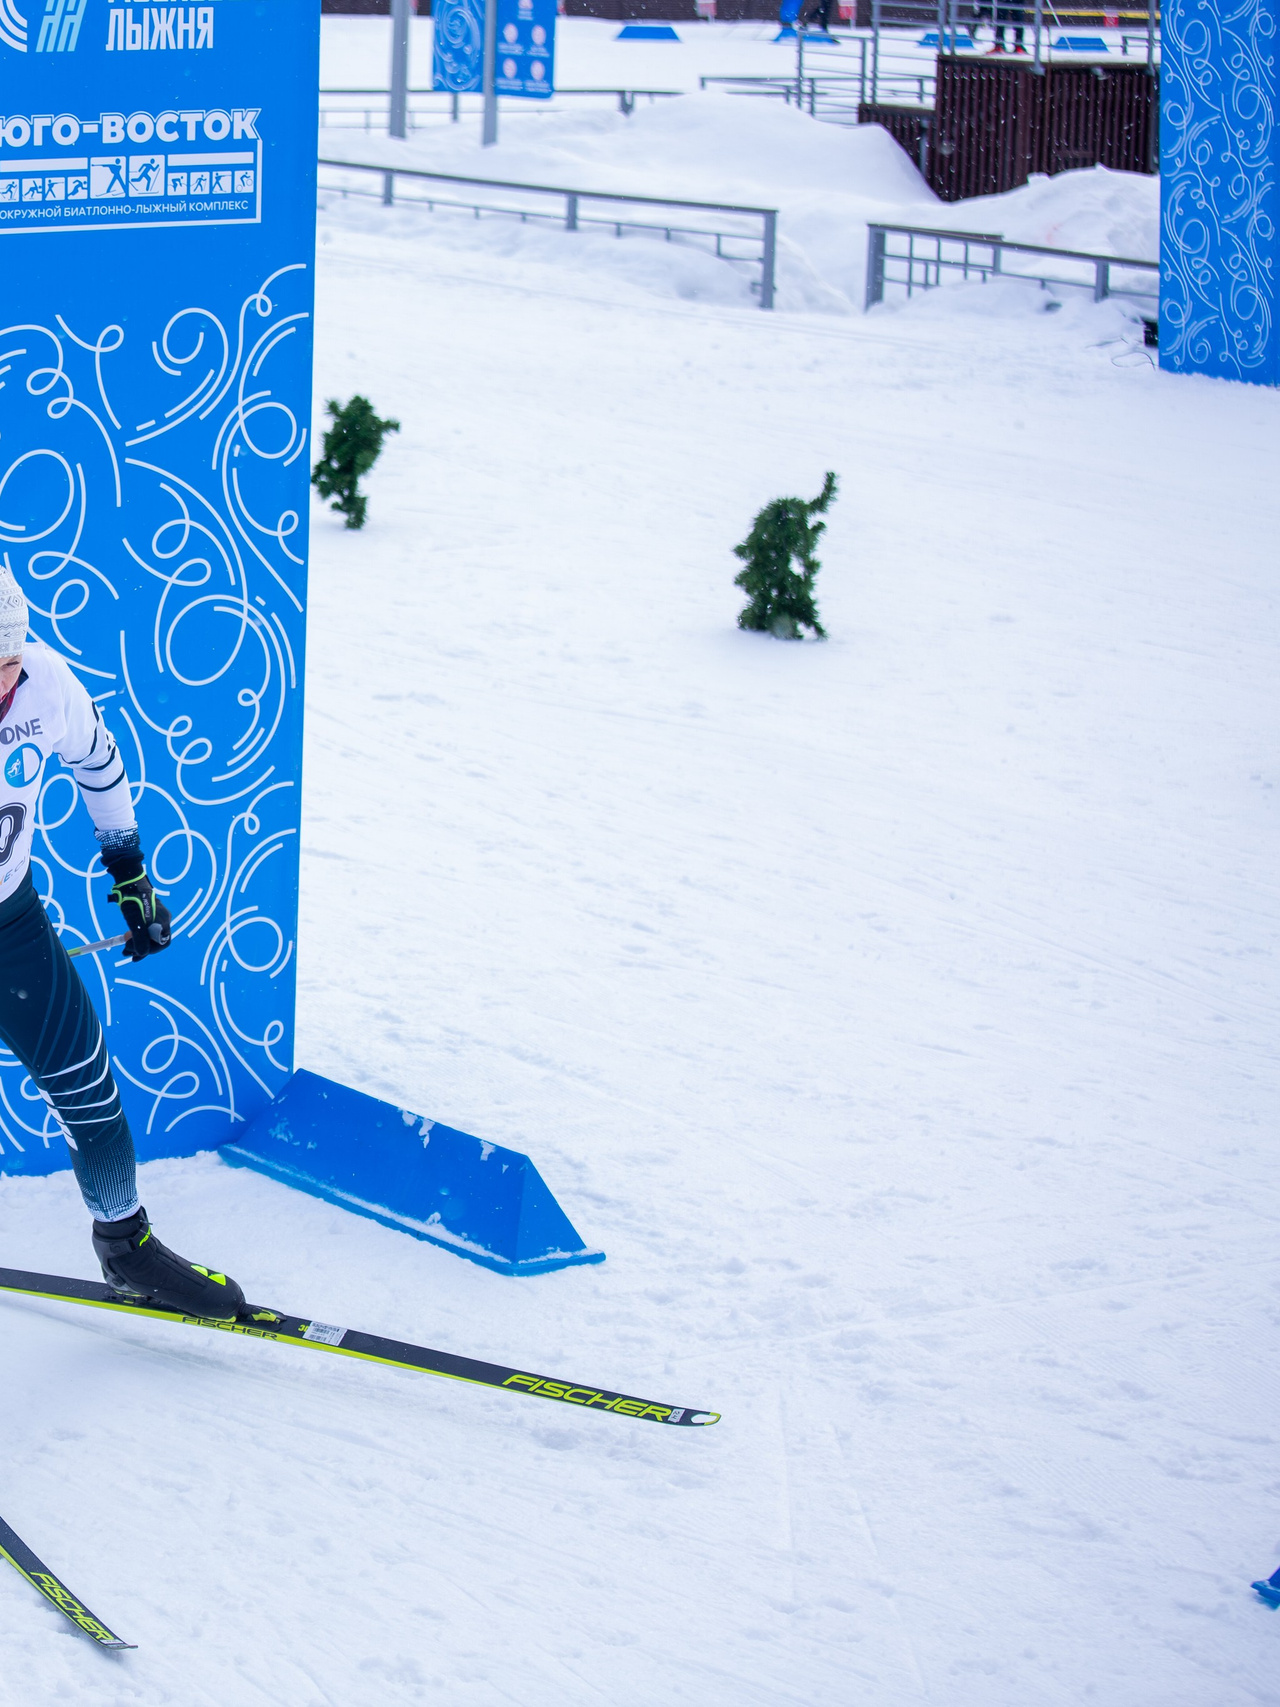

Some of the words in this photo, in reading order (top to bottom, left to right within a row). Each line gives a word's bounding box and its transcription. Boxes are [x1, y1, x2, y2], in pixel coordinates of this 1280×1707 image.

[106, 7, 214, 51] ЛЫЖНЯ
[0, 207, 61, 220] ОКРУЖНОЙ
[64, 201, 186, 217] БИАТЛОННО-ЛЫЖНЫЙ
[189, 200, 248, 213] КОМПЛЕКС
[182, 1317, 278, 1341] FISCHER
[502, 1374, 672, 1422] FISCHER
[30, 1572, 114, 1640] FISCHER
